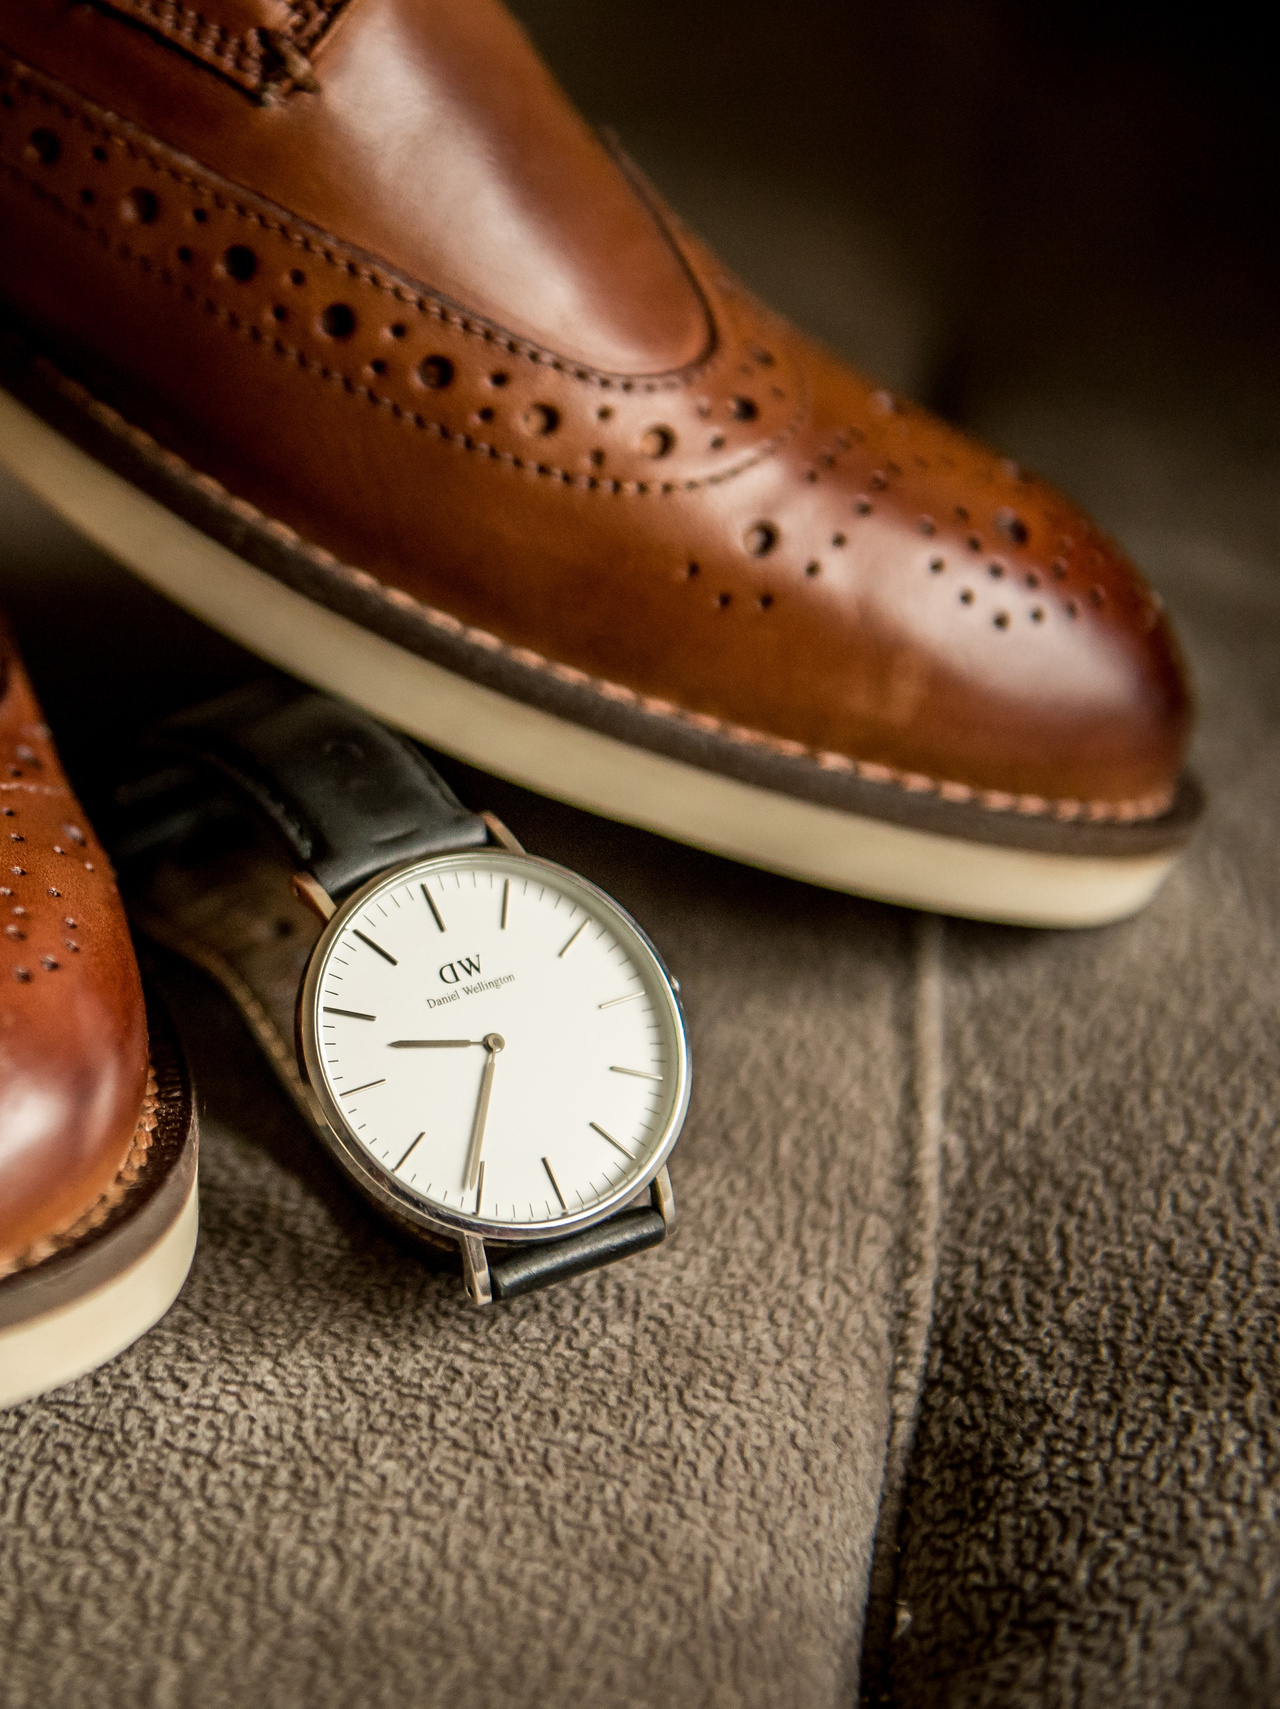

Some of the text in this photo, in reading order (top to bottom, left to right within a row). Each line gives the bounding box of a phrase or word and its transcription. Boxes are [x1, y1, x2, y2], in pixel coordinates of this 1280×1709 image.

[439, 953, 481, 985] DW
[426, 974, 516, 1009] Daniel Wellington
